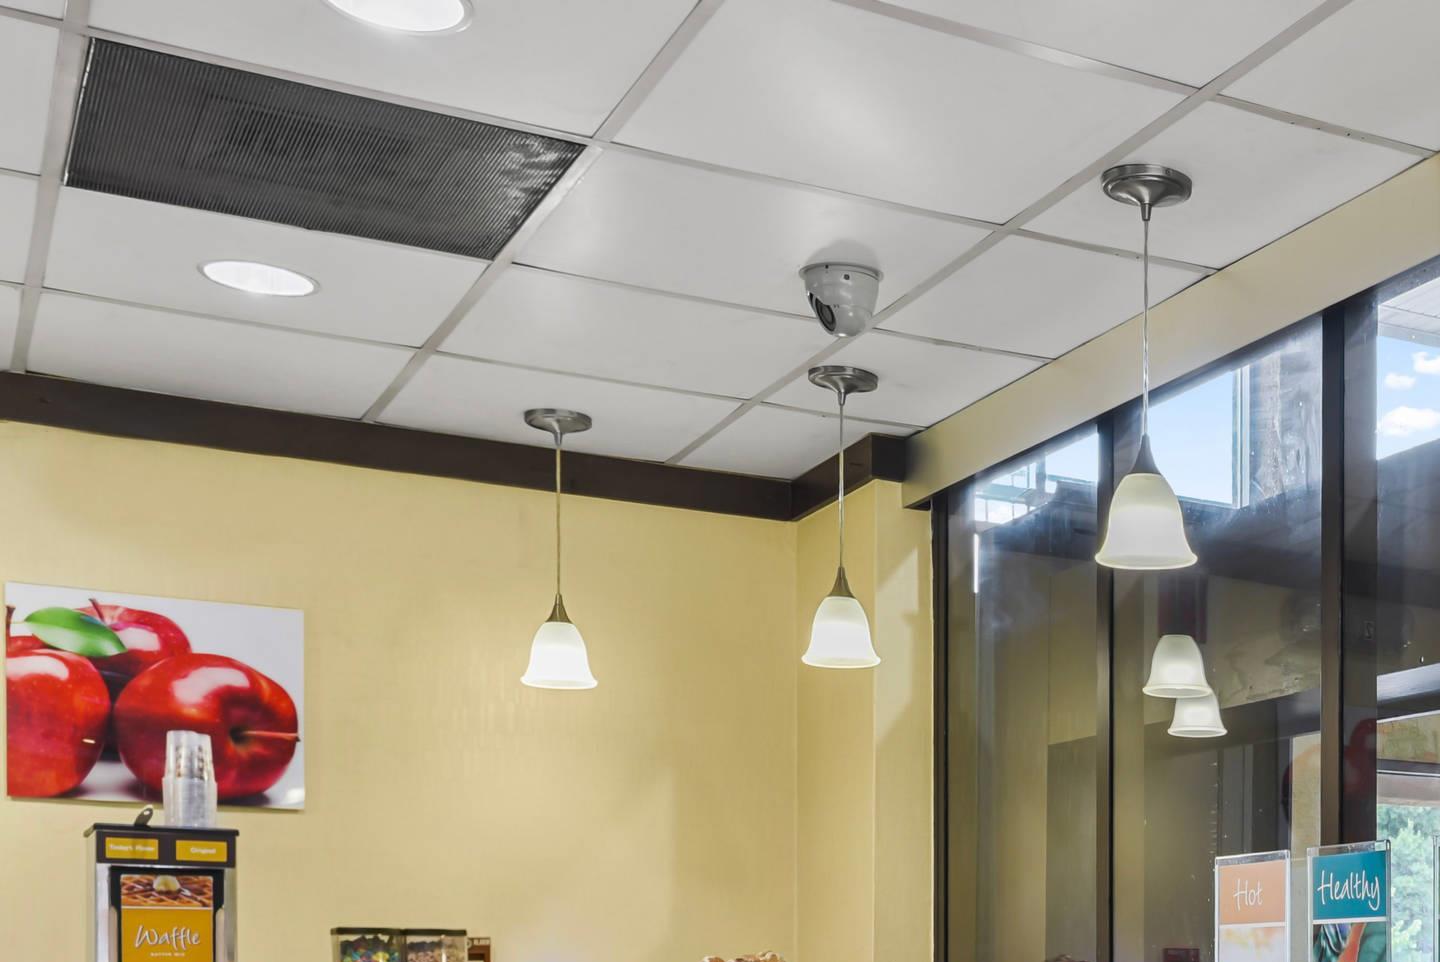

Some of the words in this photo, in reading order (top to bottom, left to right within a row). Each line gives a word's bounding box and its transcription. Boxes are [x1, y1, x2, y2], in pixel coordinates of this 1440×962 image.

[1233, 878, 1263, 910] Hot
[1318, 870, 1380, 911] Healthy
[135, 924, 200, 950] Waffle
